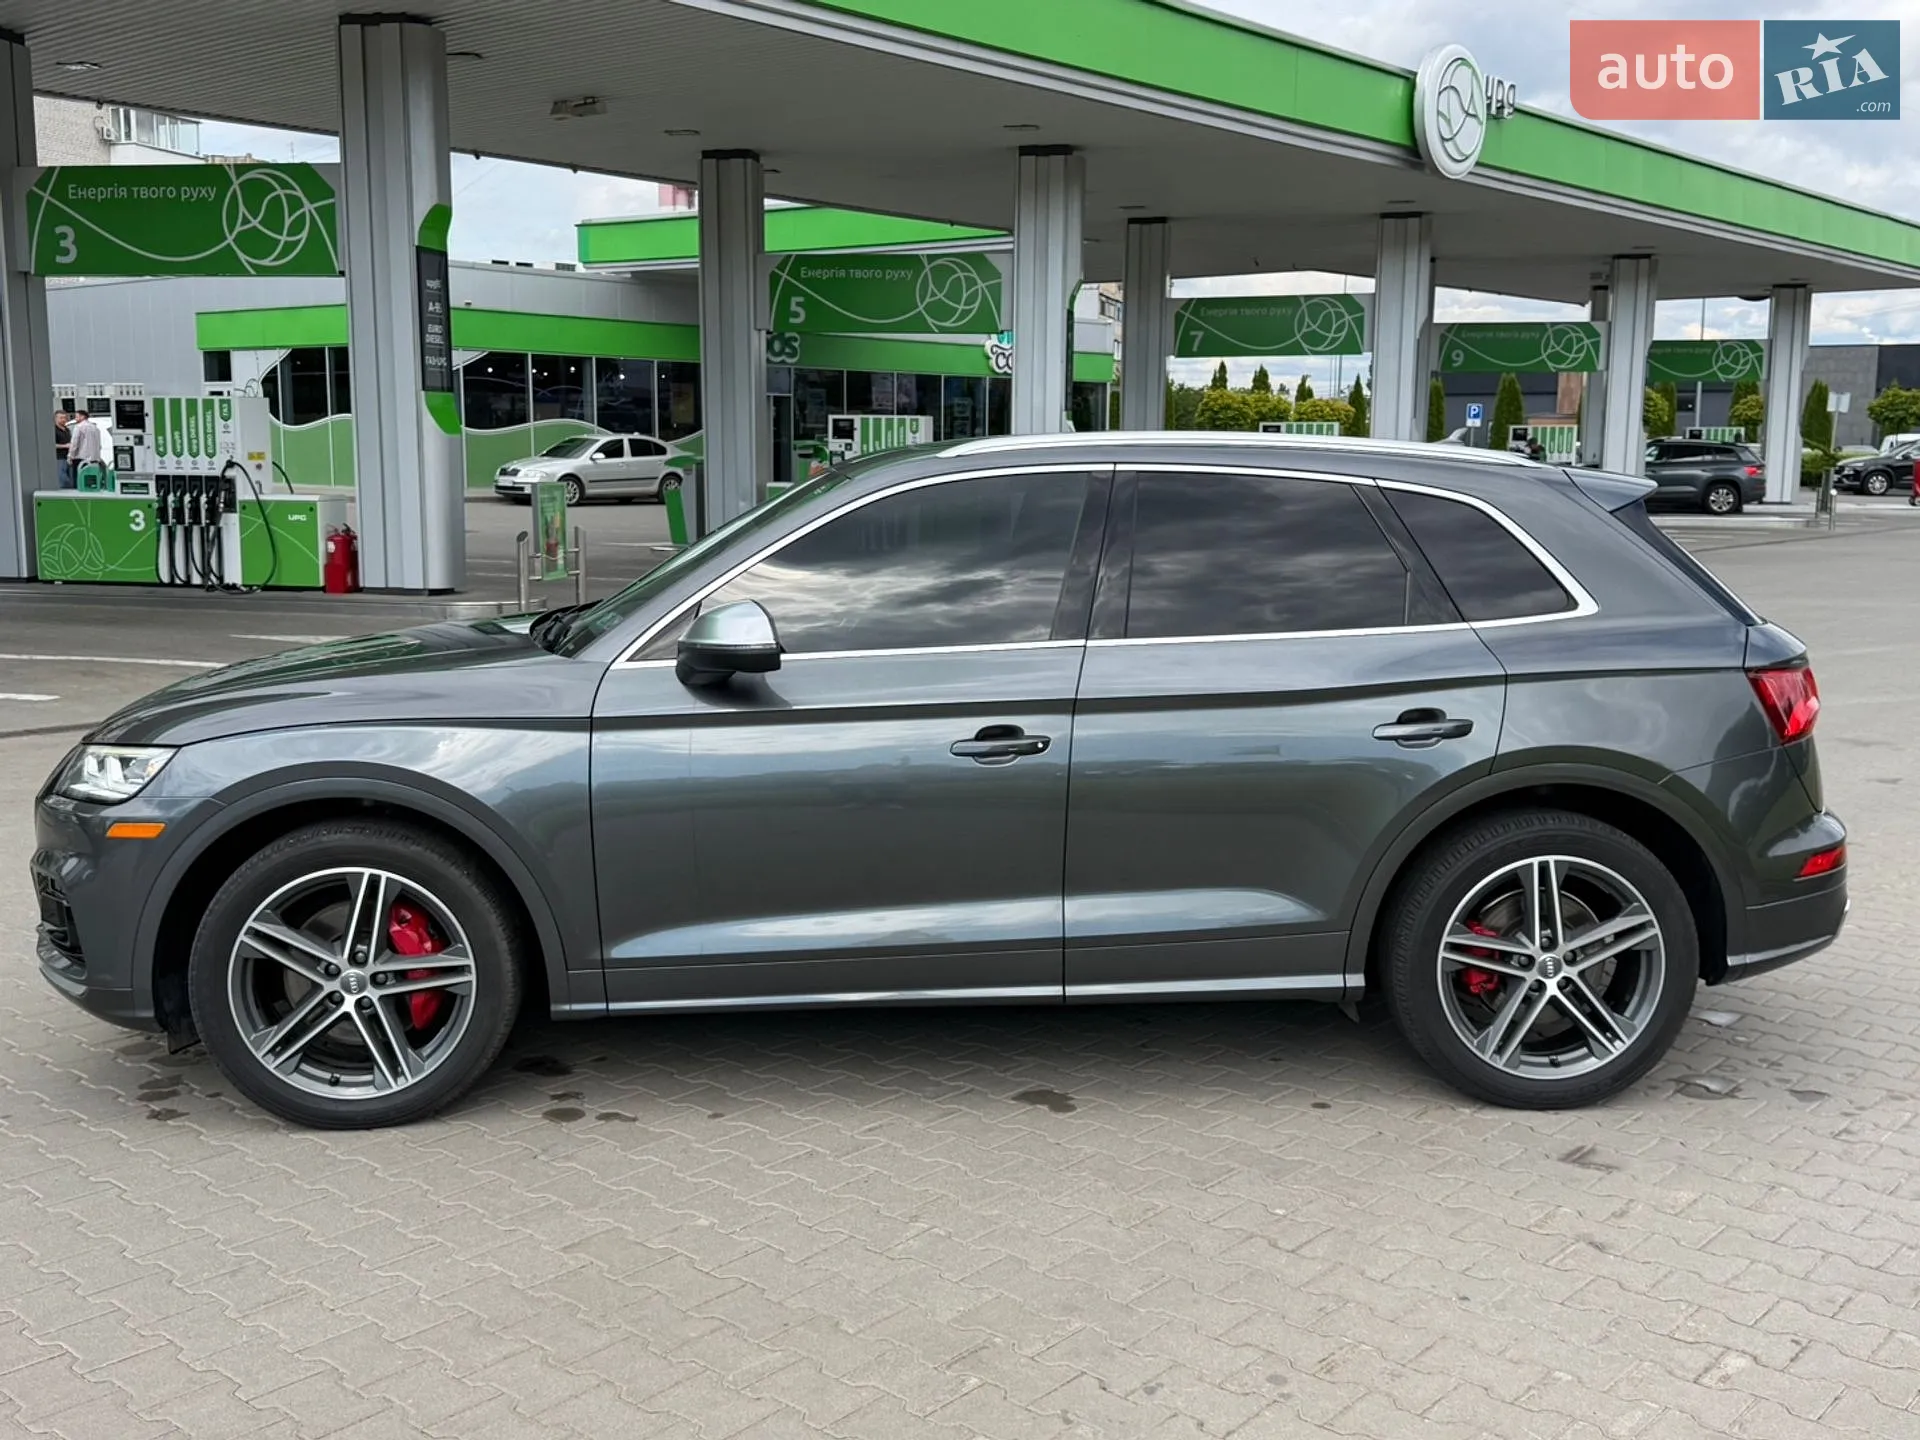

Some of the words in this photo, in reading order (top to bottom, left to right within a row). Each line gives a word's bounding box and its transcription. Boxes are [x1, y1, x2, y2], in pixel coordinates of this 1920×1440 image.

[68, 183, 128, 202] Енергія
[131, 186, 177, 199] твого
[180, 185, 217, 202] руху
[54, 225, 78, 264] 3
[800, 266, 847, 280] Енергія
[849, 268, 883, 279] твого
[885, 267, 913, 281] руху
[788, 296, 806, 324] 5
[1189, 330, 1204, 352] 7
[1451, 348, 1465, 367] 9
[1470, 405, 1479, 418] P
[129, 509, 146, 531] 3
